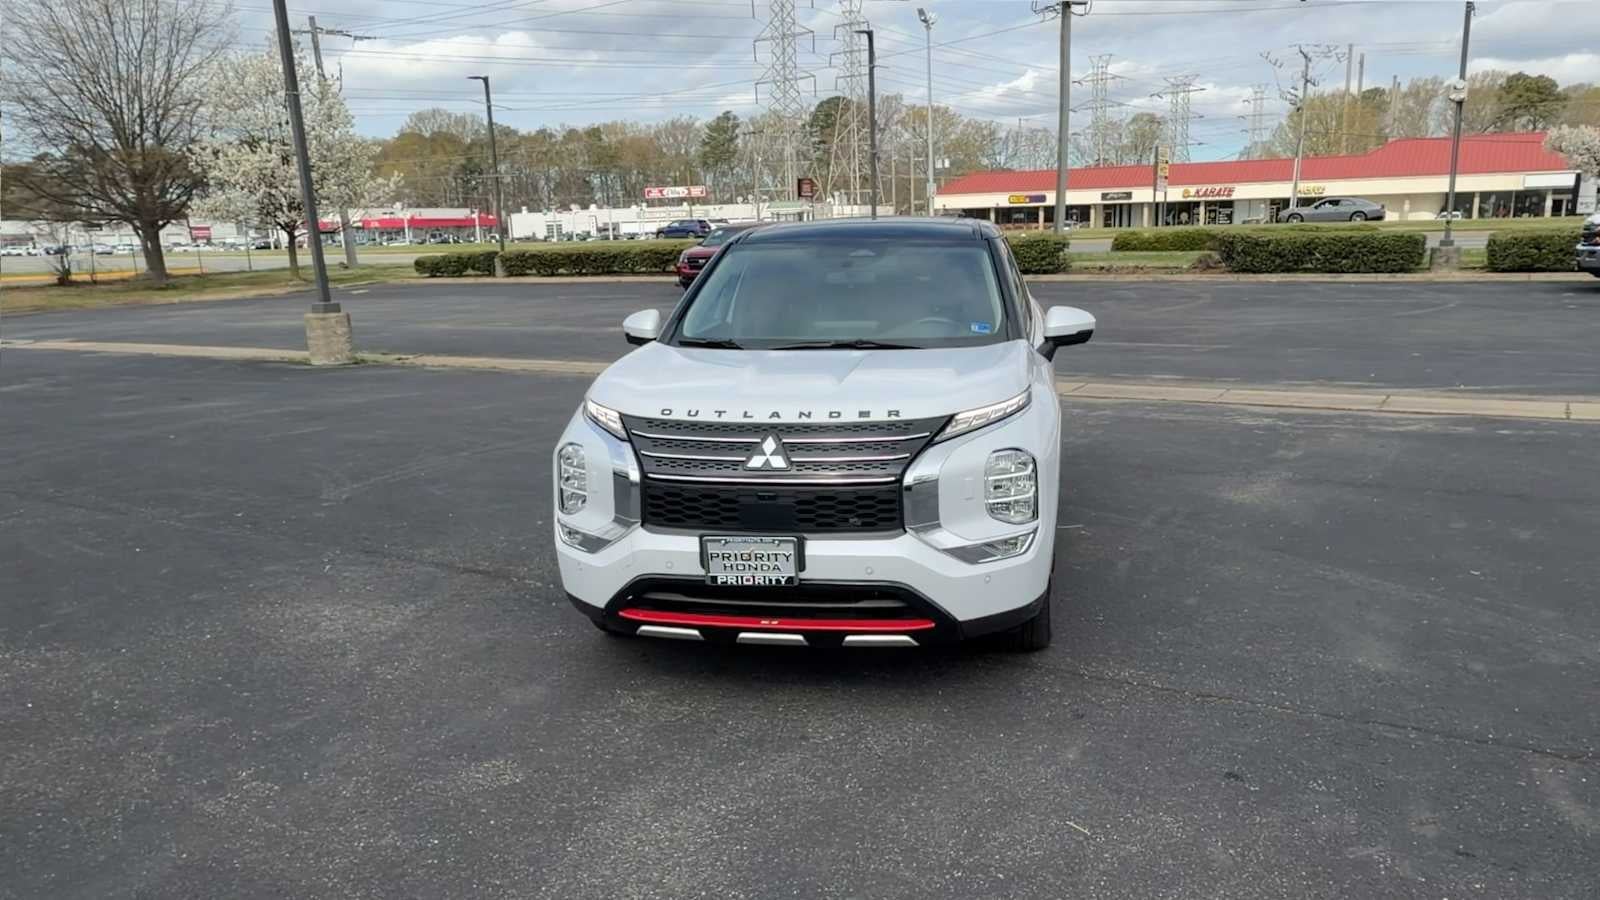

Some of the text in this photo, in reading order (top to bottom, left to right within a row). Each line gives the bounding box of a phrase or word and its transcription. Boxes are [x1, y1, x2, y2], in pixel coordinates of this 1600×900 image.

[1194, 186, 1236, 197] KARATE
[660, 408, 902, 419] OUTLANDER
[710, 552, 792, 562] PRIORITY
[723, 563, 781, 572] HONDA
[717, 575, 787, 585] PRIORITY
